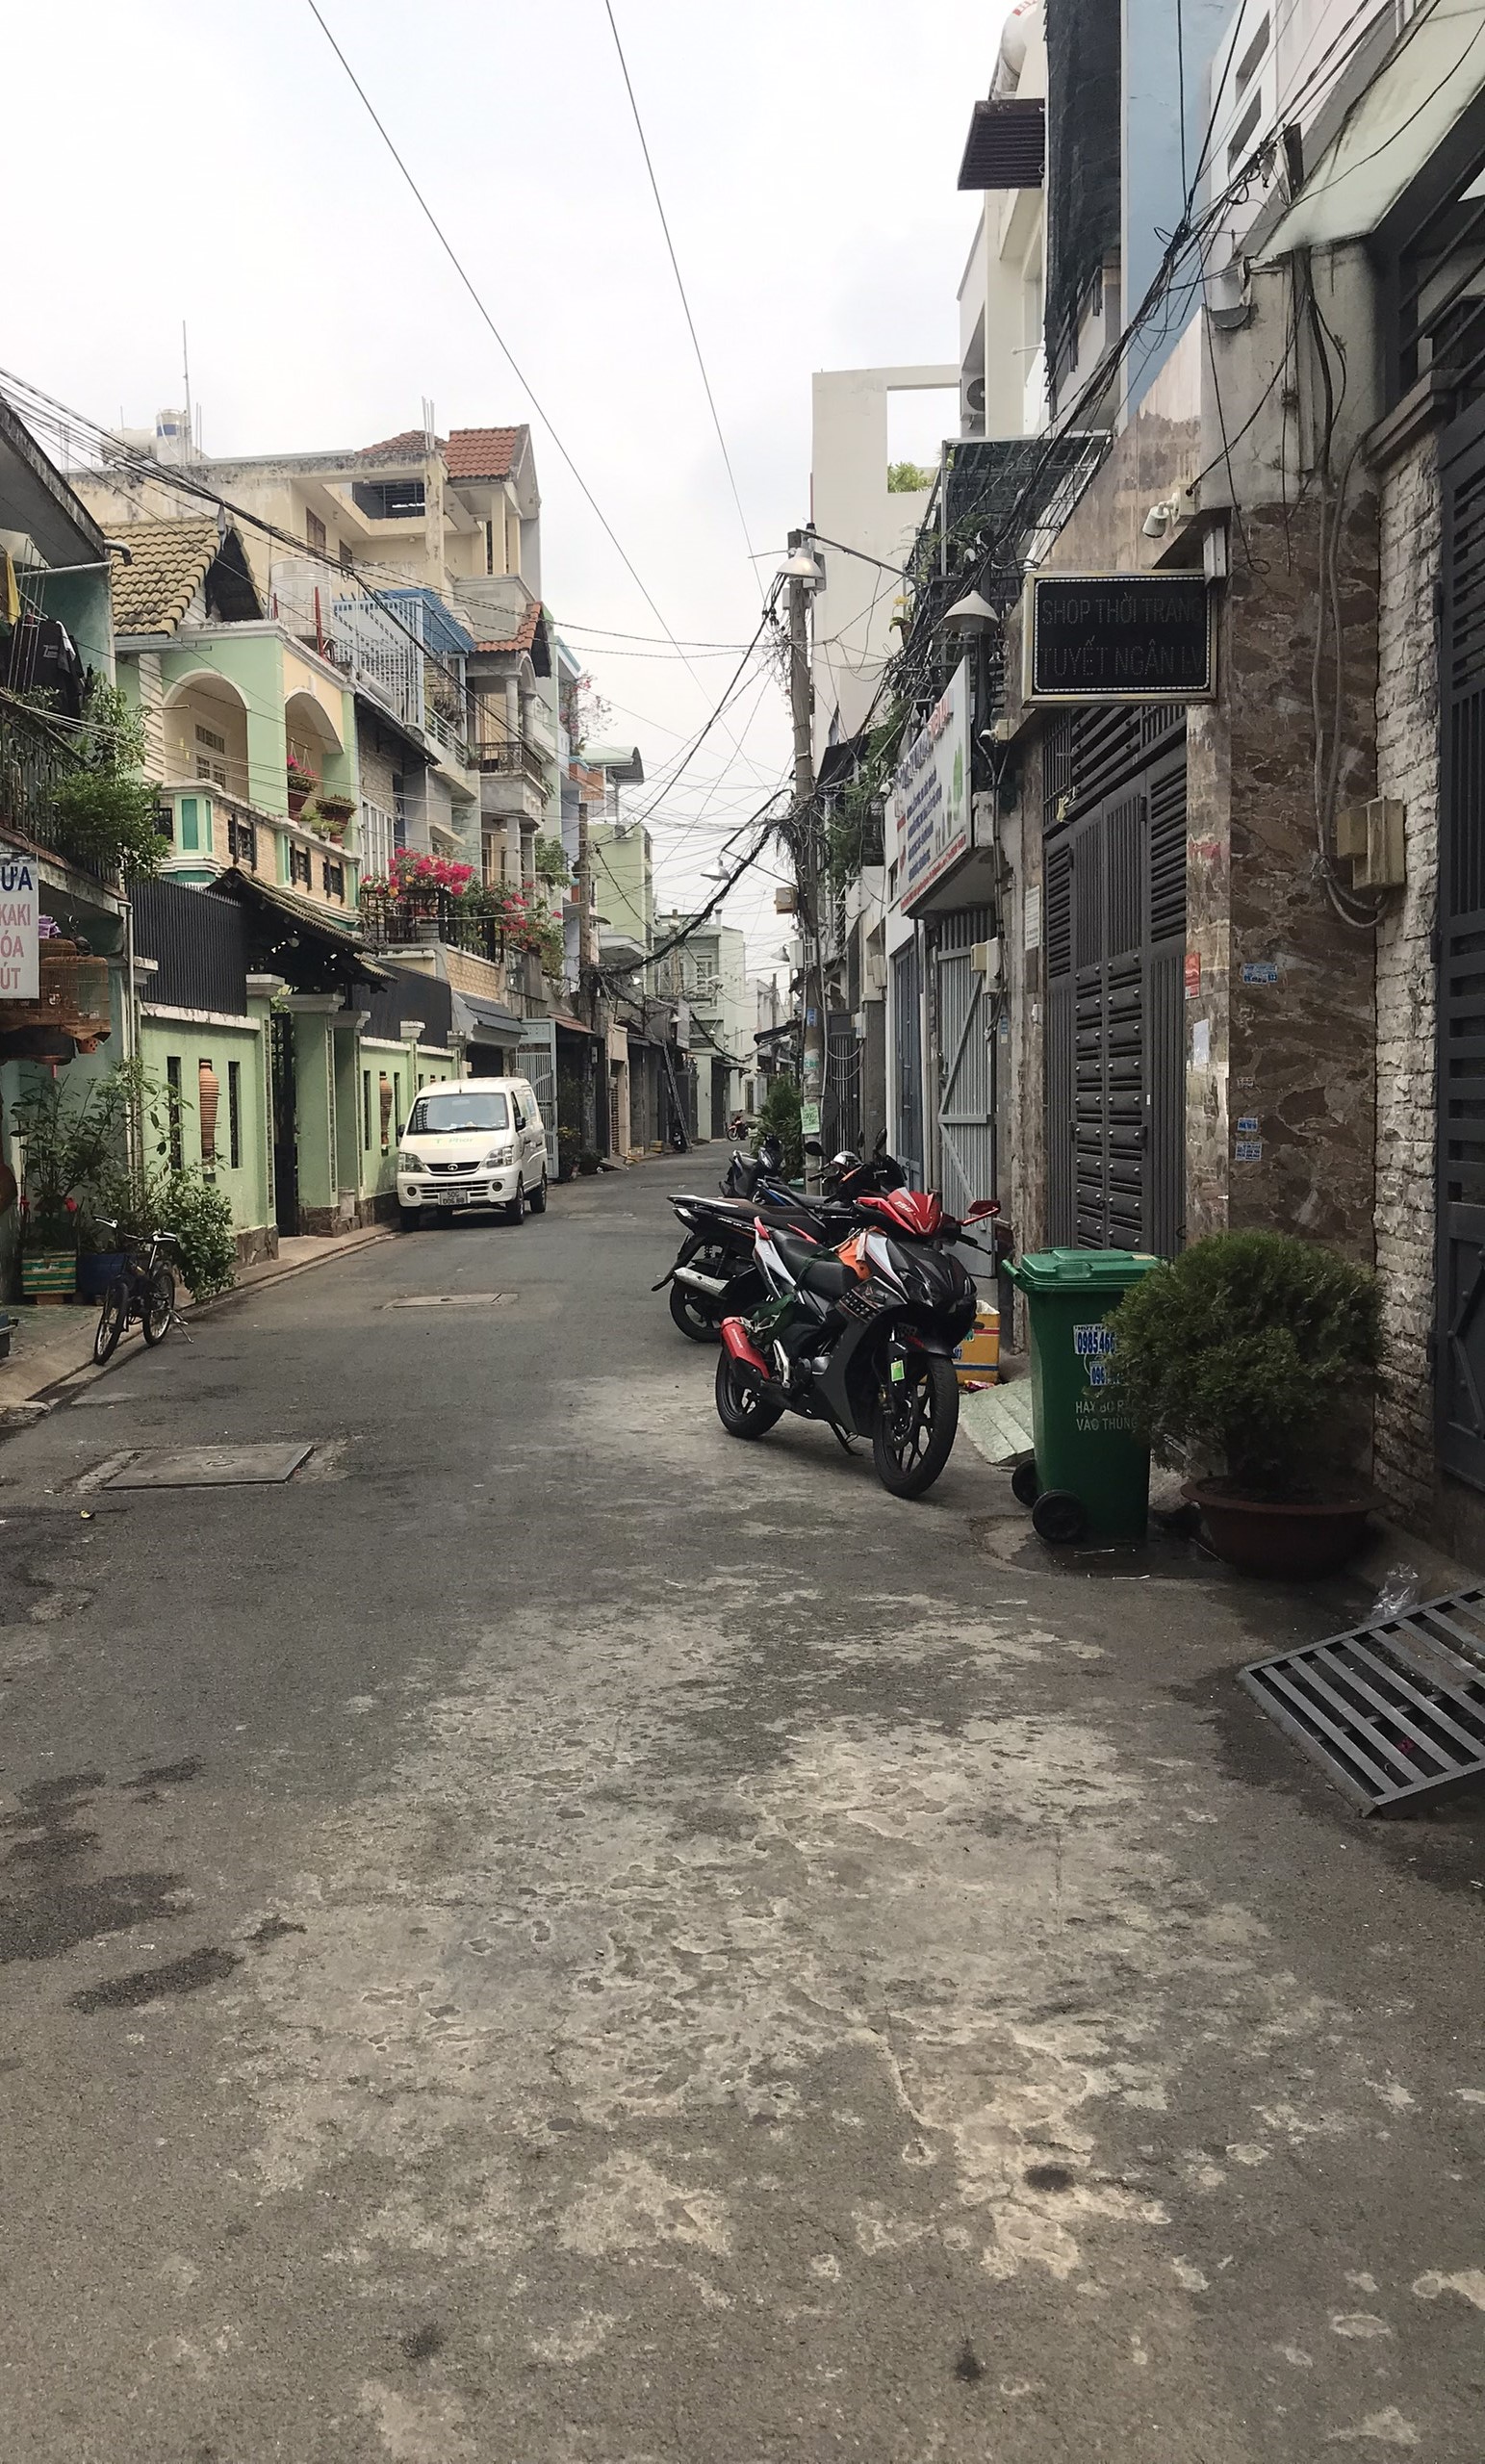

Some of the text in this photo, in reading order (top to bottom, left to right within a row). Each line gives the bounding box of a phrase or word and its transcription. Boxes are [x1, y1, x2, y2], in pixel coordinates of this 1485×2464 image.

[1042, 599, 1090, 624] SHOP
[1095, 592, 1137, 624] THỜI
[1039, 635, 1108, 676] TUYẾT
[1114, 638, 1175, 676] NGÂN
